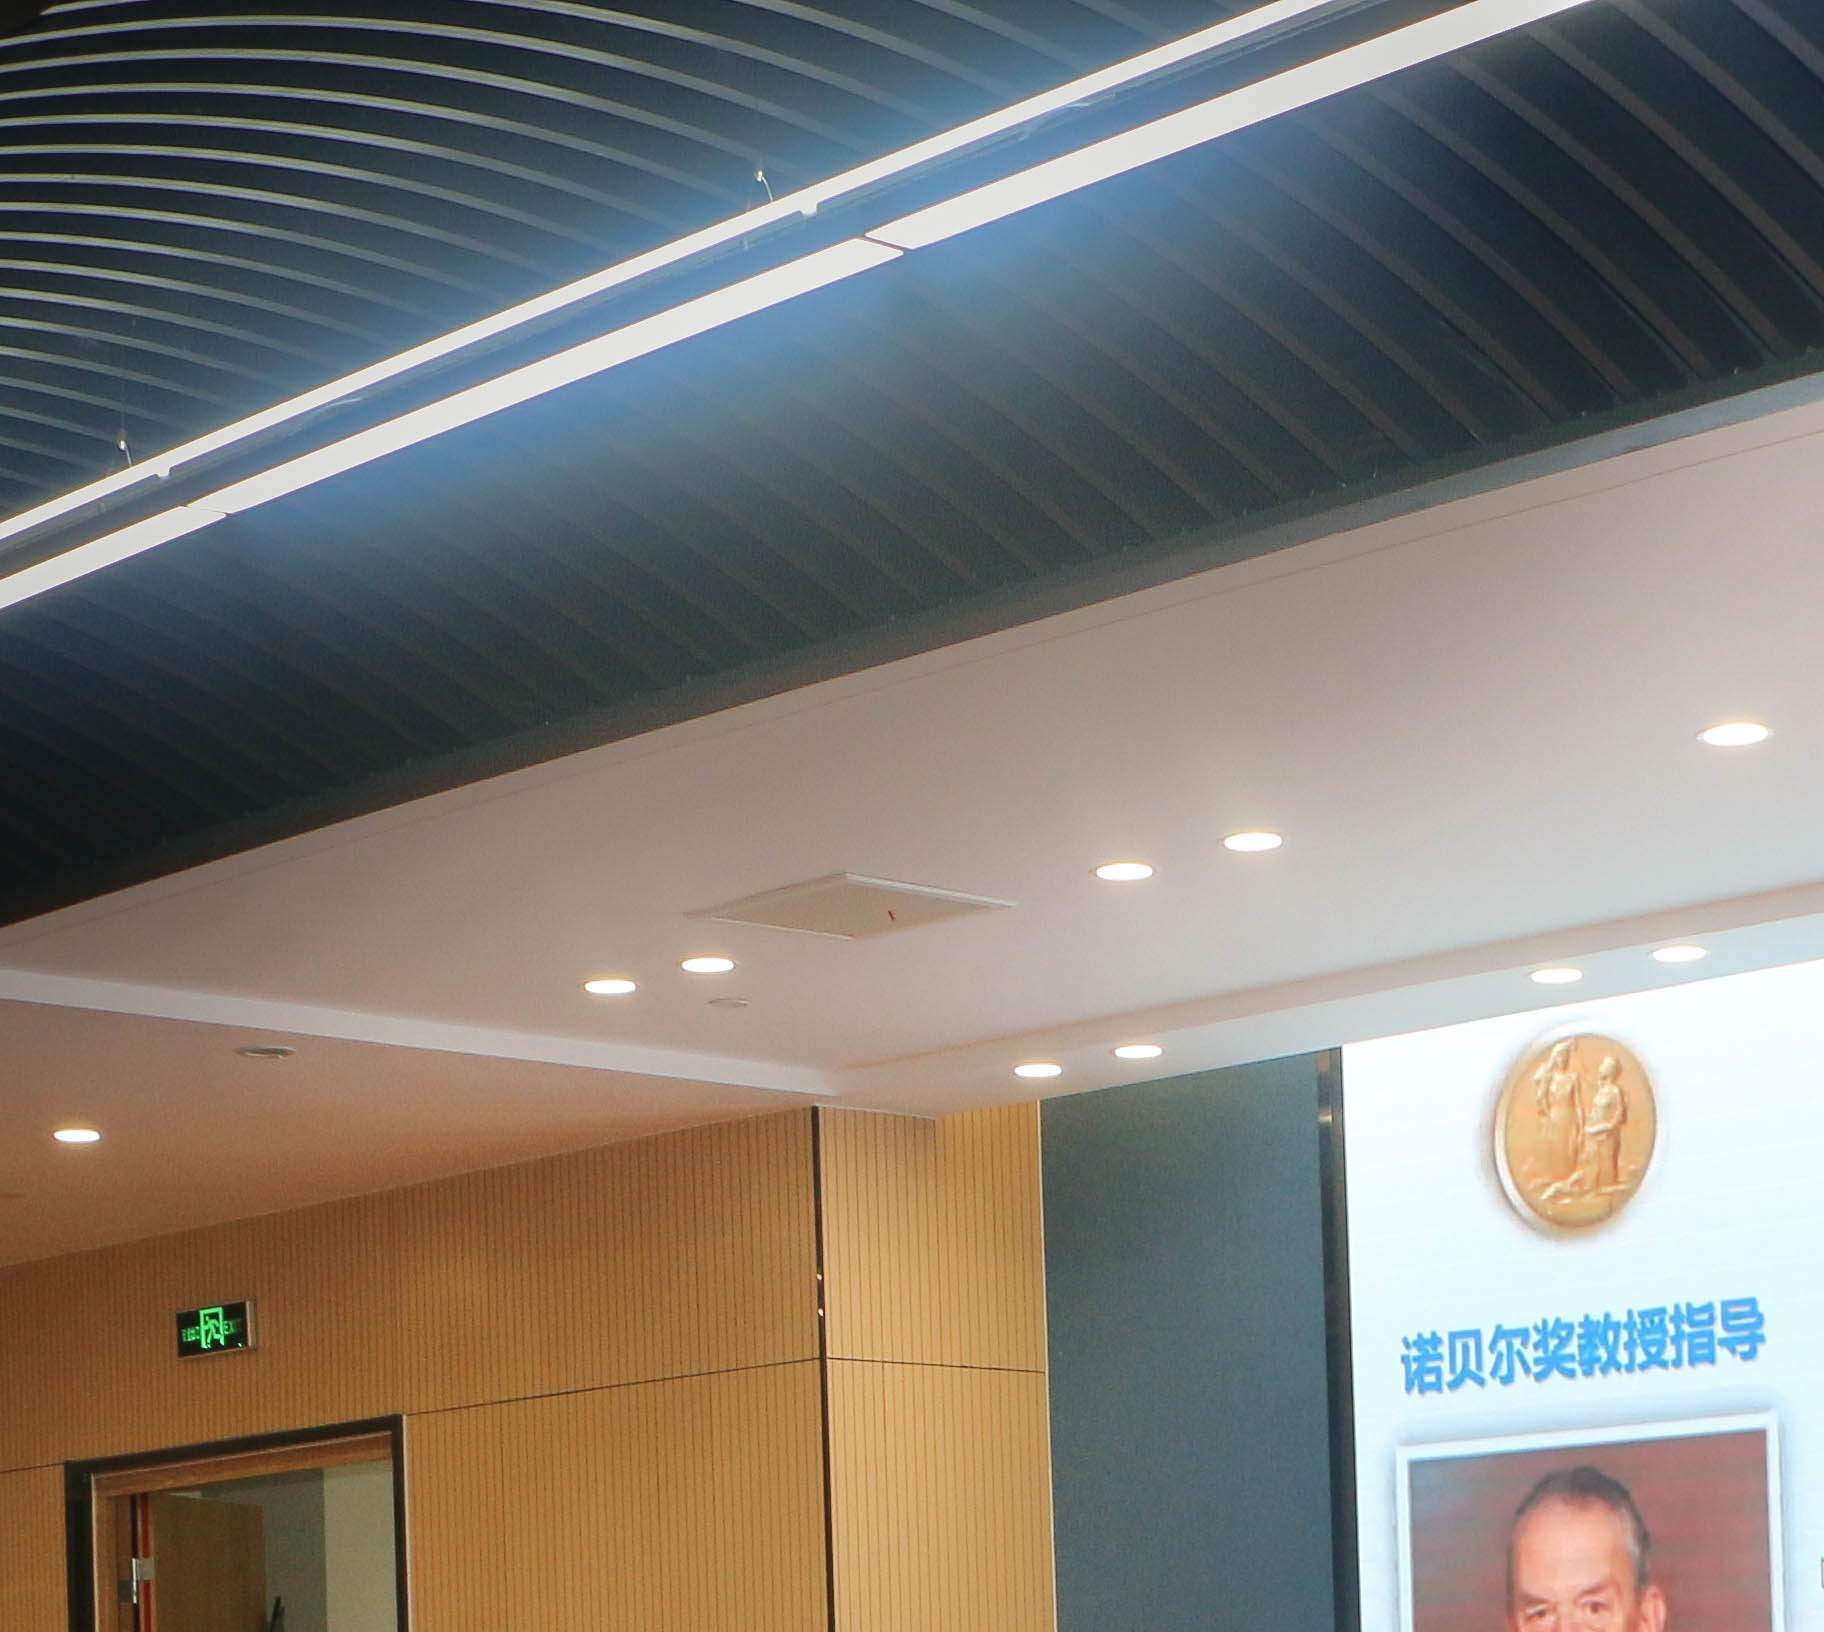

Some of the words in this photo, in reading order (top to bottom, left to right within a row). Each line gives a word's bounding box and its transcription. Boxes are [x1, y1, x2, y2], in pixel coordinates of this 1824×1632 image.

[1400, 1295, 1767, 1396] 诺贝尔奖教授指导
